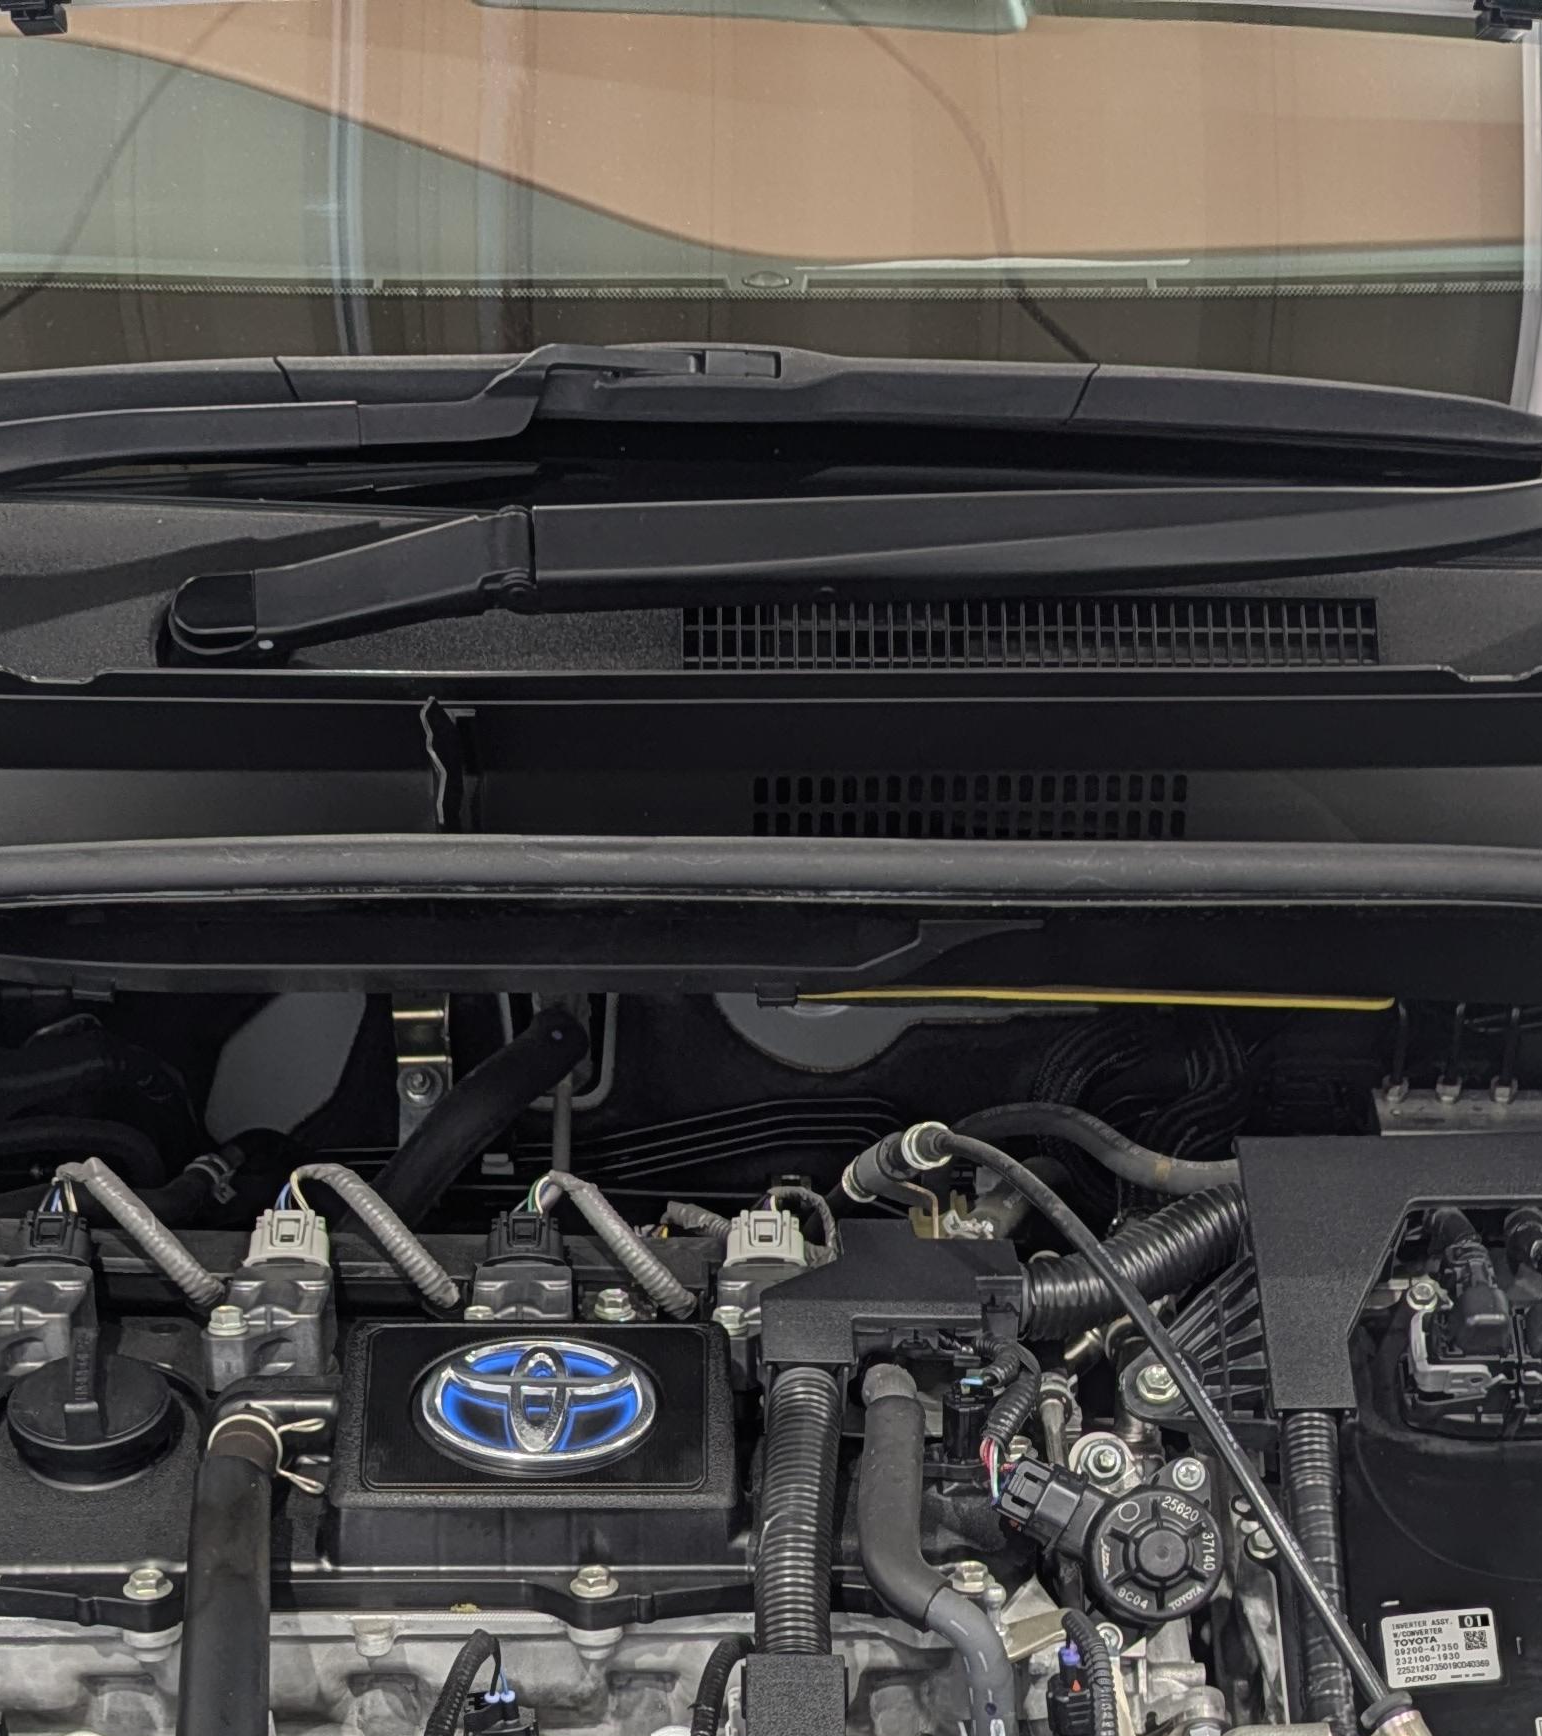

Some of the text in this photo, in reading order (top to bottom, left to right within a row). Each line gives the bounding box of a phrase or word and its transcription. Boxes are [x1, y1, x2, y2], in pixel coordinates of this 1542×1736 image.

[1161, 1495, 1200, 1522] 25620
[1168, 1585, 1205, 1611] TOYOTA
[1391, 1617, 1454, 1630] INVERTER ASSY.
[1463, 1615, 1483, 1627] 01
[1392, 1627, 1443, 1639] W/CONVERTER
[1393, 1636, 1438, 1647] TOYOTA
[1395, 1652, 1461, 1666] 232100-1930
[1404, 1674, 1437, 1684] DENSO
